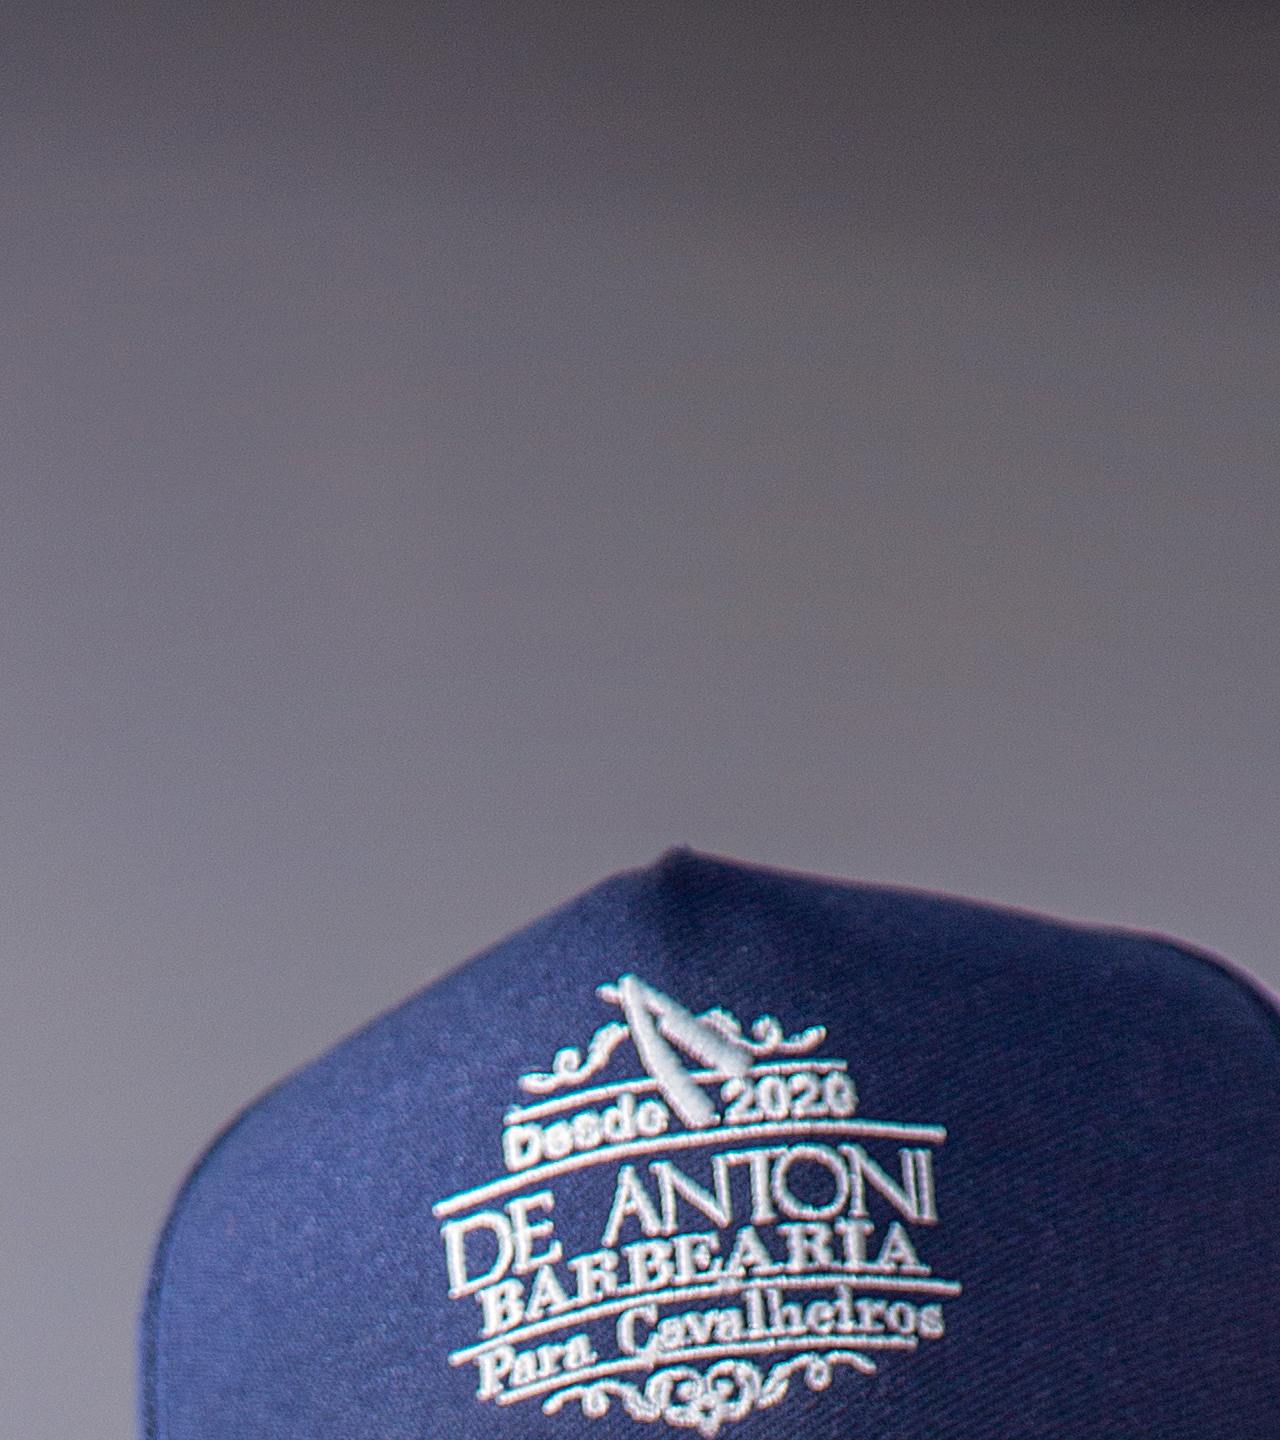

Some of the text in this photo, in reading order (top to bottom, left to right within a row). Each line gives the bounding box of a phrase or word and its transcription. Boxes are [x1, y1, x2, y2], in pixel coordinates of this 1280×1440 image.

[503, 1071, 858, 1172] Desde 2020
[440, 1191, 563, 1299] DE
[477, 1220, 932, 1338] BARBEARIA
[477, 1286, 945, 1400] Para Cavalheiros
